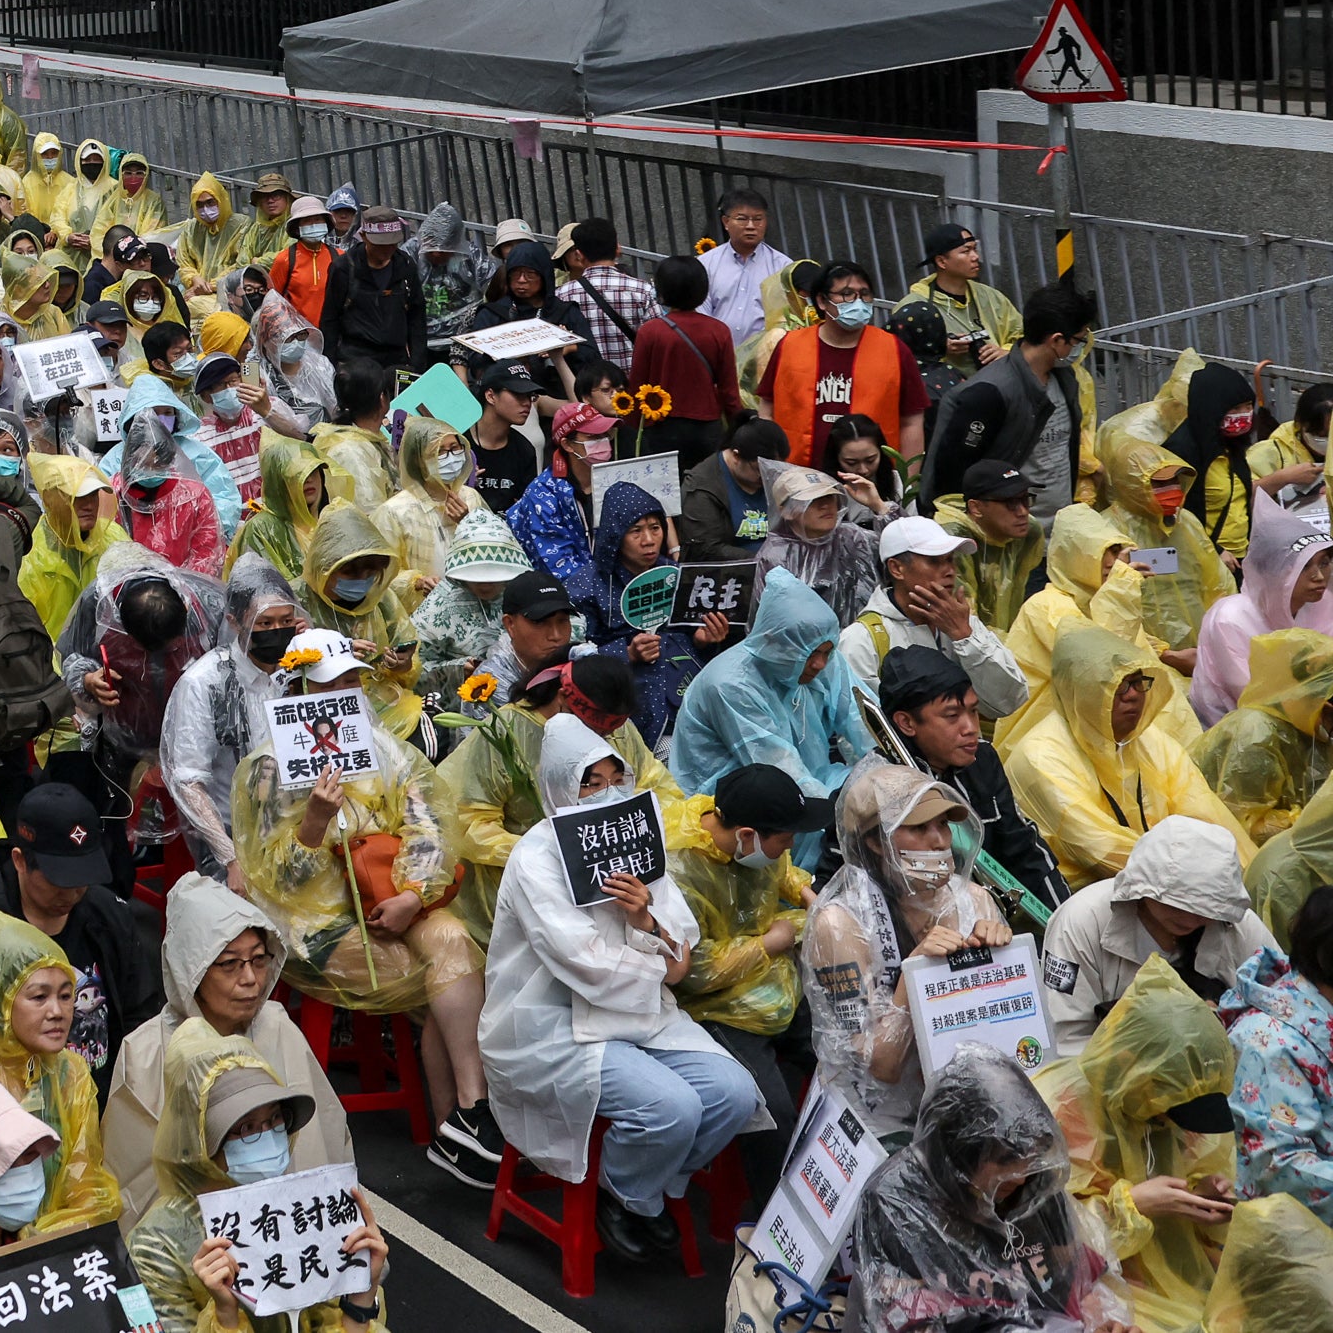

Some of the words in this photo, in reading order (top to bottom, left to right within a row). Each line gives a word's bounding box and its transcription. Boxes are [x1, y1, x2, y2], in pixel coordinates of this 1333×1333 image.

[39, 347, 77, 368] 違法的
[44, 360, 84, 381] 在立法
[686, 575, 740, 610] 民主
[273, 695, 361, 726] 流氓行徑
[293, 731, 311, 751] 牛
[341, 723, 359, 744] 庭
[286, 749, 372, 781] 失格立委
[576, 812, 650, 853] 沒有討論
[586, 847, 657, 888] 不是民主
[924, 965, 1027, 998] 程序正義是法治基礎
[932, 996, 1034, 1031] 封殺提案是威權復辟
[819, 1121, 860, 1180] 重大法案
[210, 1186, 360, 1250] 沒有討論
[768, 1214, 805, 1277] 民主法治
